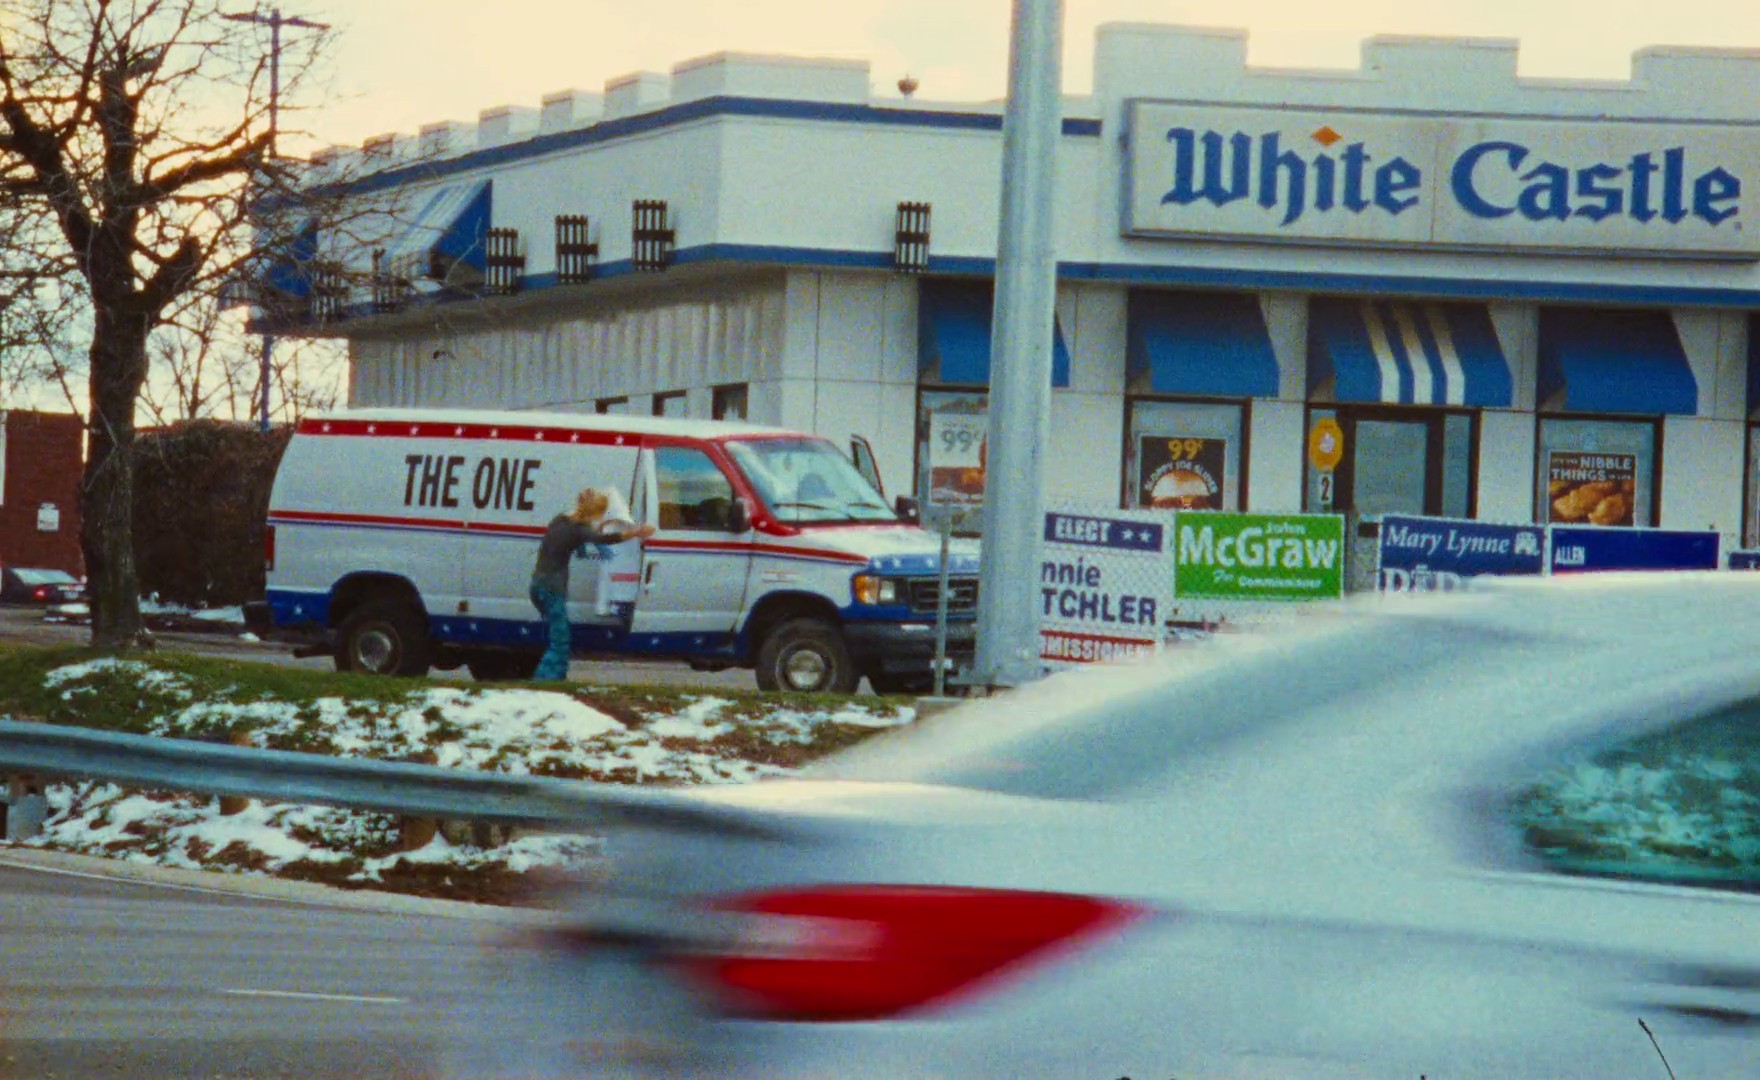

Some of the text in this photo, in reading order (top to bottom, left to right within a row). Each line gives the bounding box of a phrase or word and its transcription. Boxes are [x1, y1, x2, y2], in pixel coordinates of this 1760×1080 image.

[1161, 125, 1742, 227] White Castle
[1551, 468, 1607, 481] THINGS
[1580, 456, 1633, 470] NIBBLE
[404, 454, 541, 510] THE ONE
[1321, 476, 1330, 501] 2
[1055, 517, 1111, 542] ELECT
[1266, 521, 1307, 535] John
[1386, 525, 1511, 558] Mary Lynne
[1179, 525, 1338, 568] McGraw
[1042, 556, 1101, 587] nnie
[1041, 587, 1156, 625] TCHLER
